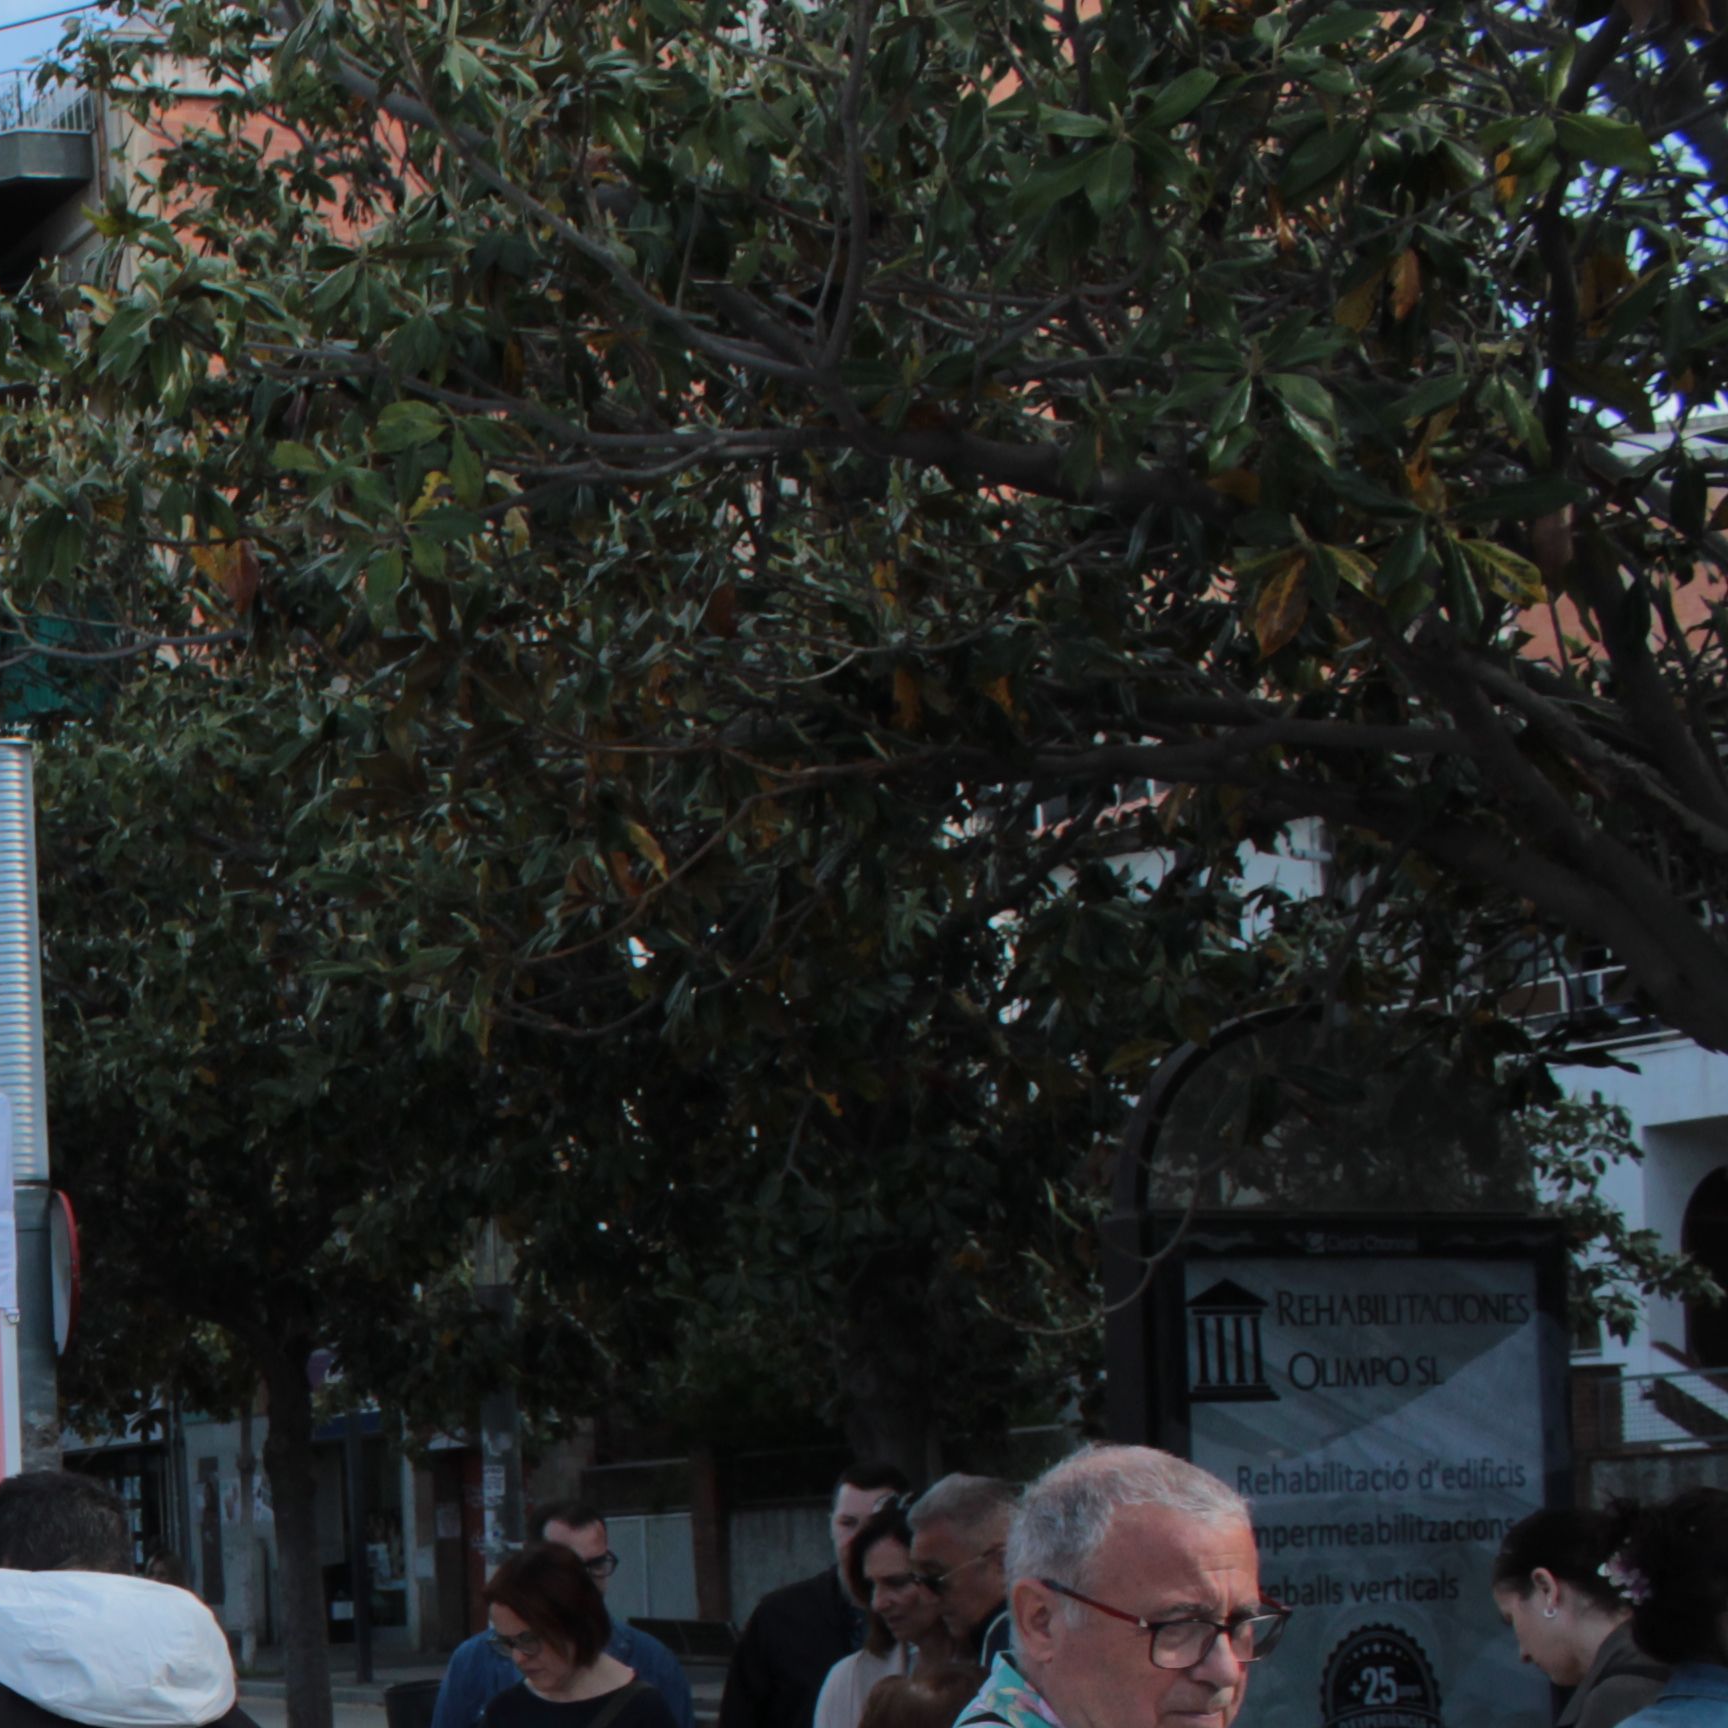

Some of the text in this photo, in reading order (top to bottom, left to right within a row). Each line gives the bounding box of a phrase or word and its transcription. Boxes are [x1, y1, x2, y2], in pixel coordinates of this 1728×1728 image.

[1276, 1290, 1531, 1328] REHABILITACIONES
[1287, 1350, 1410, 1391] OLIMPO
[1236, 1459, 1410, 1496] Rehabilitació
[1252, 1511, 1517, 1555] mpermeabilitzacions
[1350, 1567, 1461, 1603] verticals
